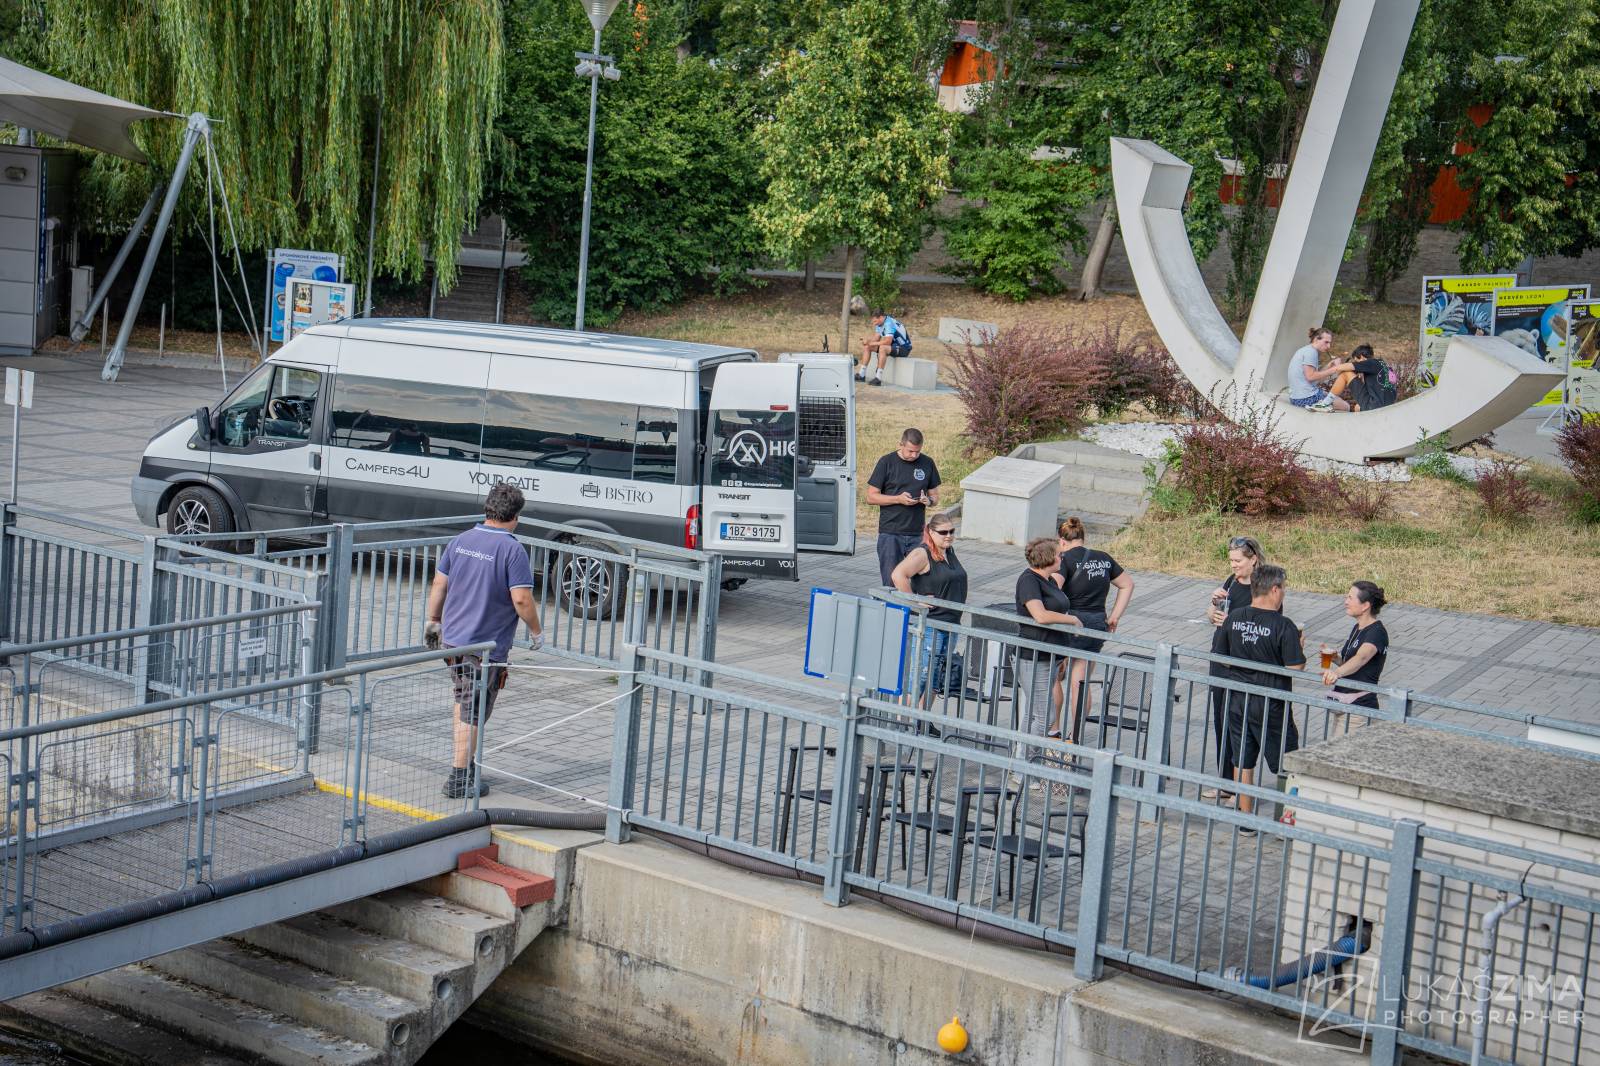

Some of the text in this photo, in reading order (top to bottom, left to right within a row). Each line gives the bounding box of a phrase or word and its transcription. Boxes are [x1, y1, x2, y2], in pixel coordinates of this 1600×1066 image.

[258, 439, 287, 448] TRANSIT
[605, 487, 653, 503] BISTRO
[718, 493, 751, 501] TRANSIT
[729, 526, 746, 537] 1BZ
[752, 527, 775, 538] 9179
[1232, 621, 1271, 637] HIGHLAND
